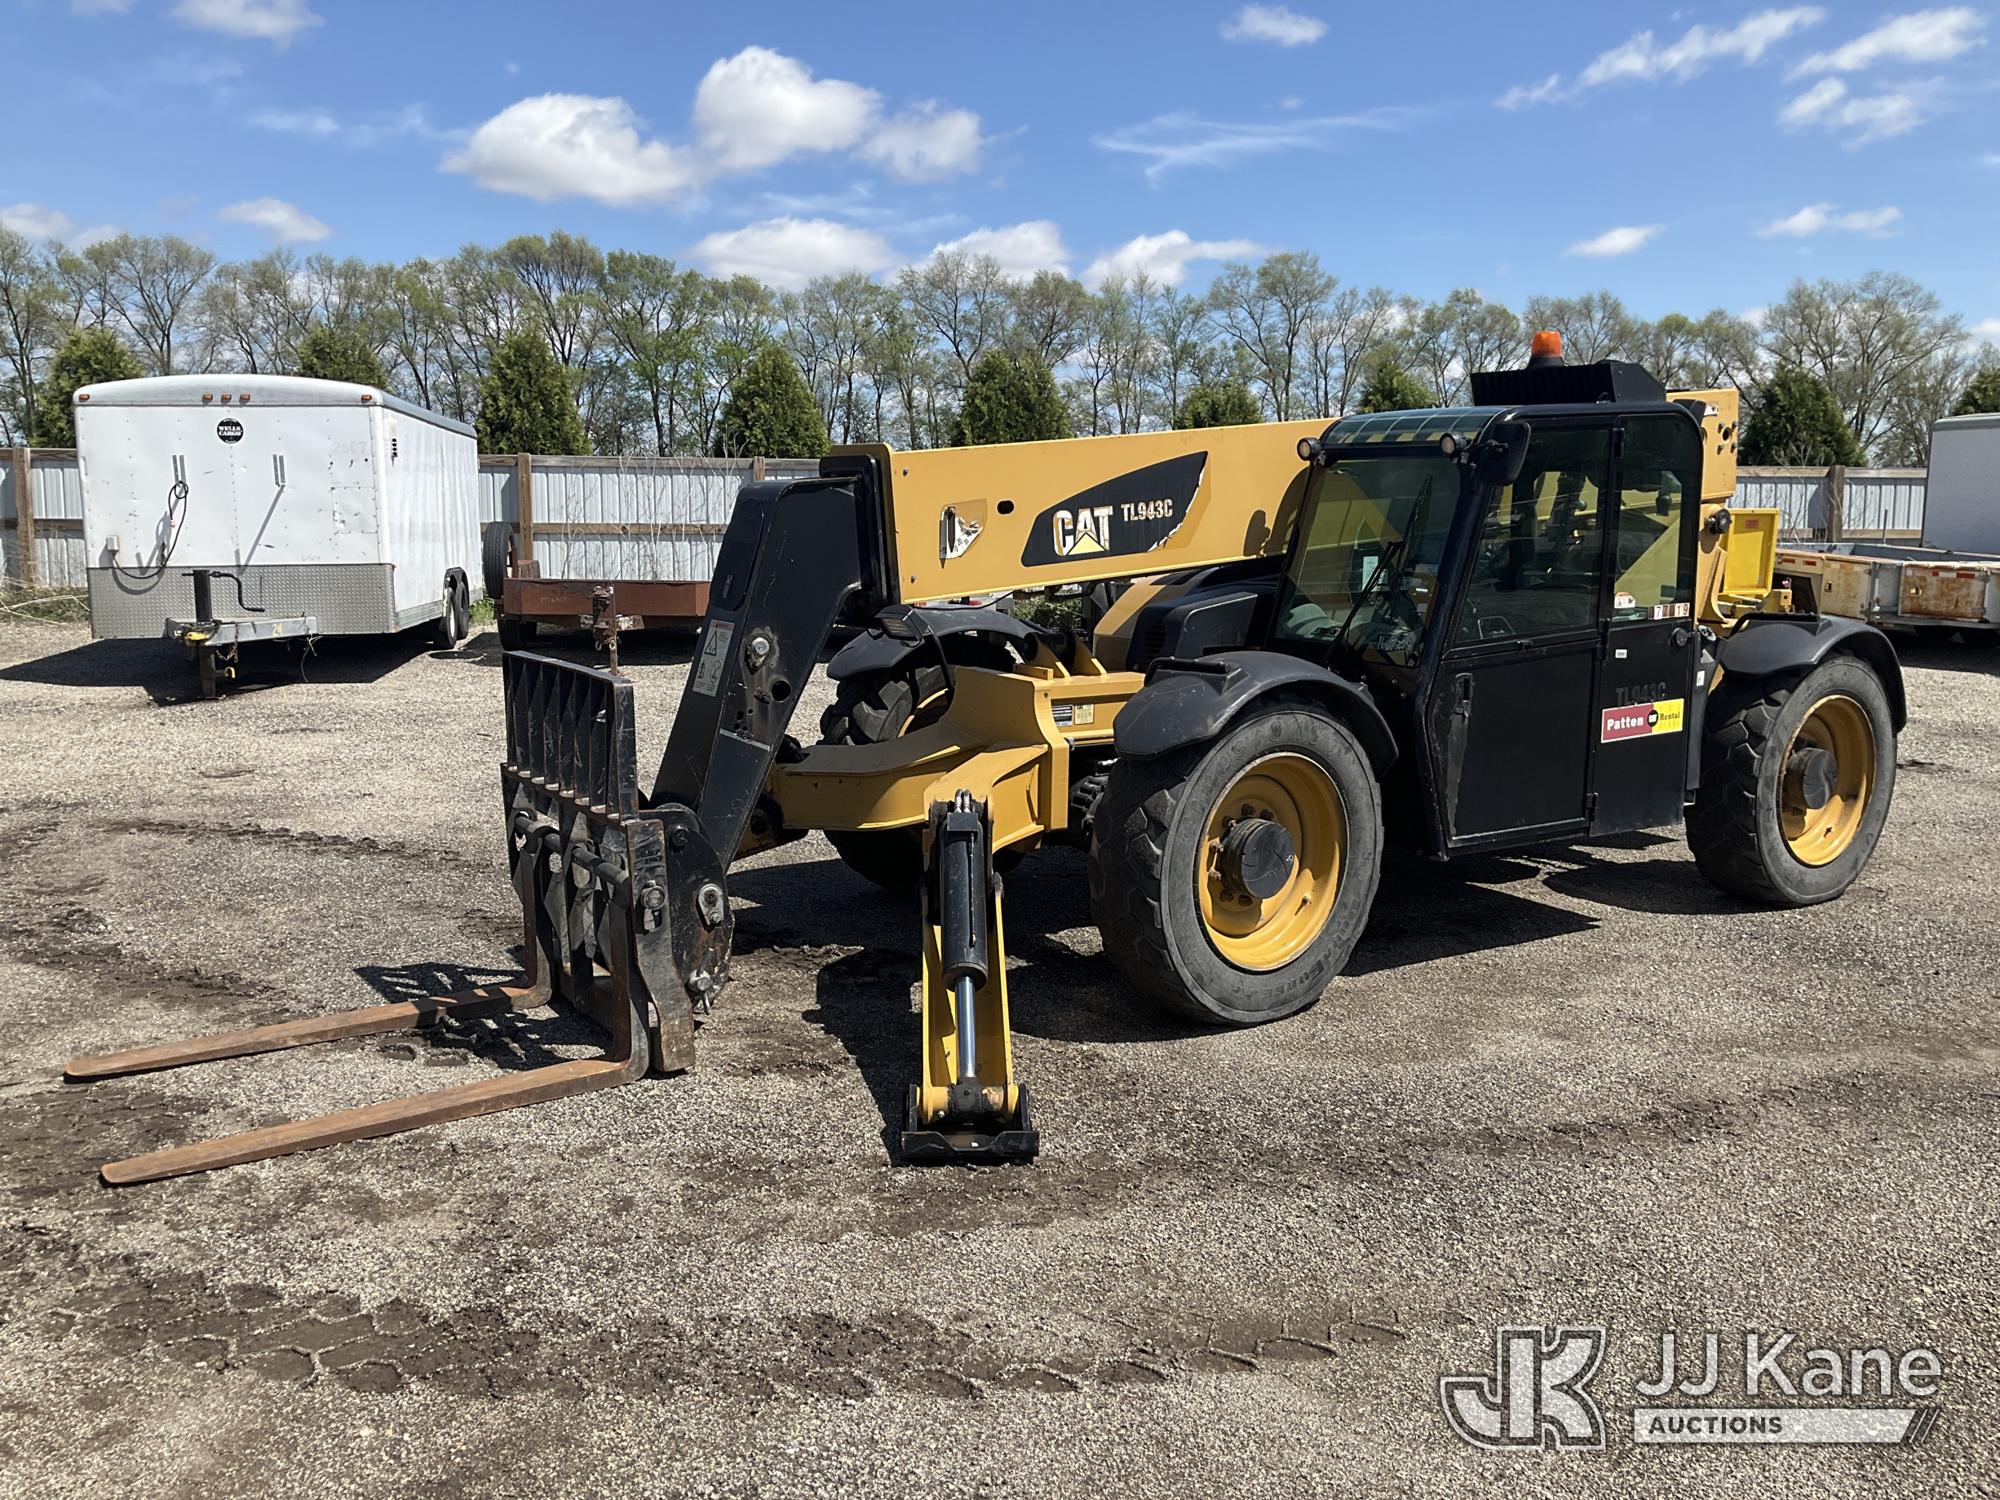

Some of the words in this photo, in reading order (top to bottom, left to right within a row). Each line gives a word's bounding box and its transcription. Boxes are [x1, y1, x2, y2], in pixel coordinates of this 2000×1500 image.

[1052, 505, 1114, 557] CAT
[1120, 498, 1174, 522] TL943C
[1606, 716, 1644, 731] Patten
[1659, 711, 1681, 721] Rental
